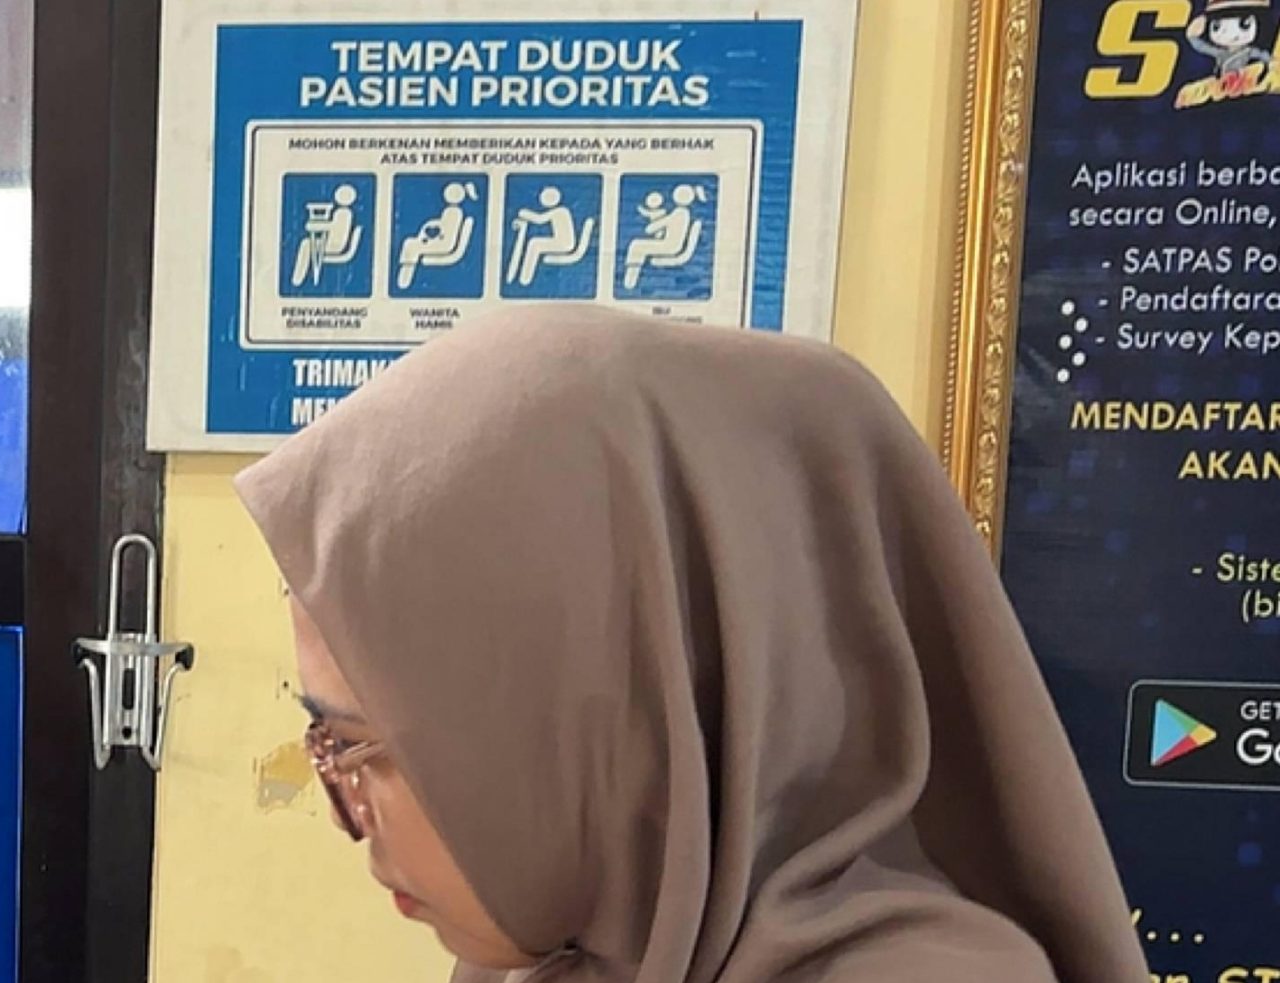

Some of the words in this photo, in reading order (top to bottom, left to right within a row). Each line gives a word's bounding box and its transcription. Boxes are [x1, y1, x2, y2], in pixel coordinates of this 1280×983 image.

[330, 40, 508, 73] TEMPAT
[519, 40, 682, 73] DUDUK
[300, 76, 459, 107] PASIEN
[471, 76, 710, 107] PRIORITAS
[288, 138, 346, 151] MOHON
[348, 138, 431, 151] BERKENAN
[433, 138, 537, 151] MEMBERIKAN
[538, 138, 601, 151] KEPADA
[604, 138, 647, 151] YANG
[649, 138, 715, 151] BERHAK
[380, 152, 418, 165] ATAS
[421, 152, 480, 165] TEMPAT
[482, 152, 537, 165] DUDUK
[538, 152, 620, 165] PRIORITAS
[1072, 160, 1187, 194] Aplikasi
[1069, 206, 1165, 227] secara
[1175, 197, 1277, 229] Online,
[1123, 246, 1233, 274] SATPAS
[1244, 246, 1280, 273] Po
[1117, 322, 1214, 355] Survey
[1224, 322, 1280, 355] Kep
[1240, 700, 1280, 720] GET
